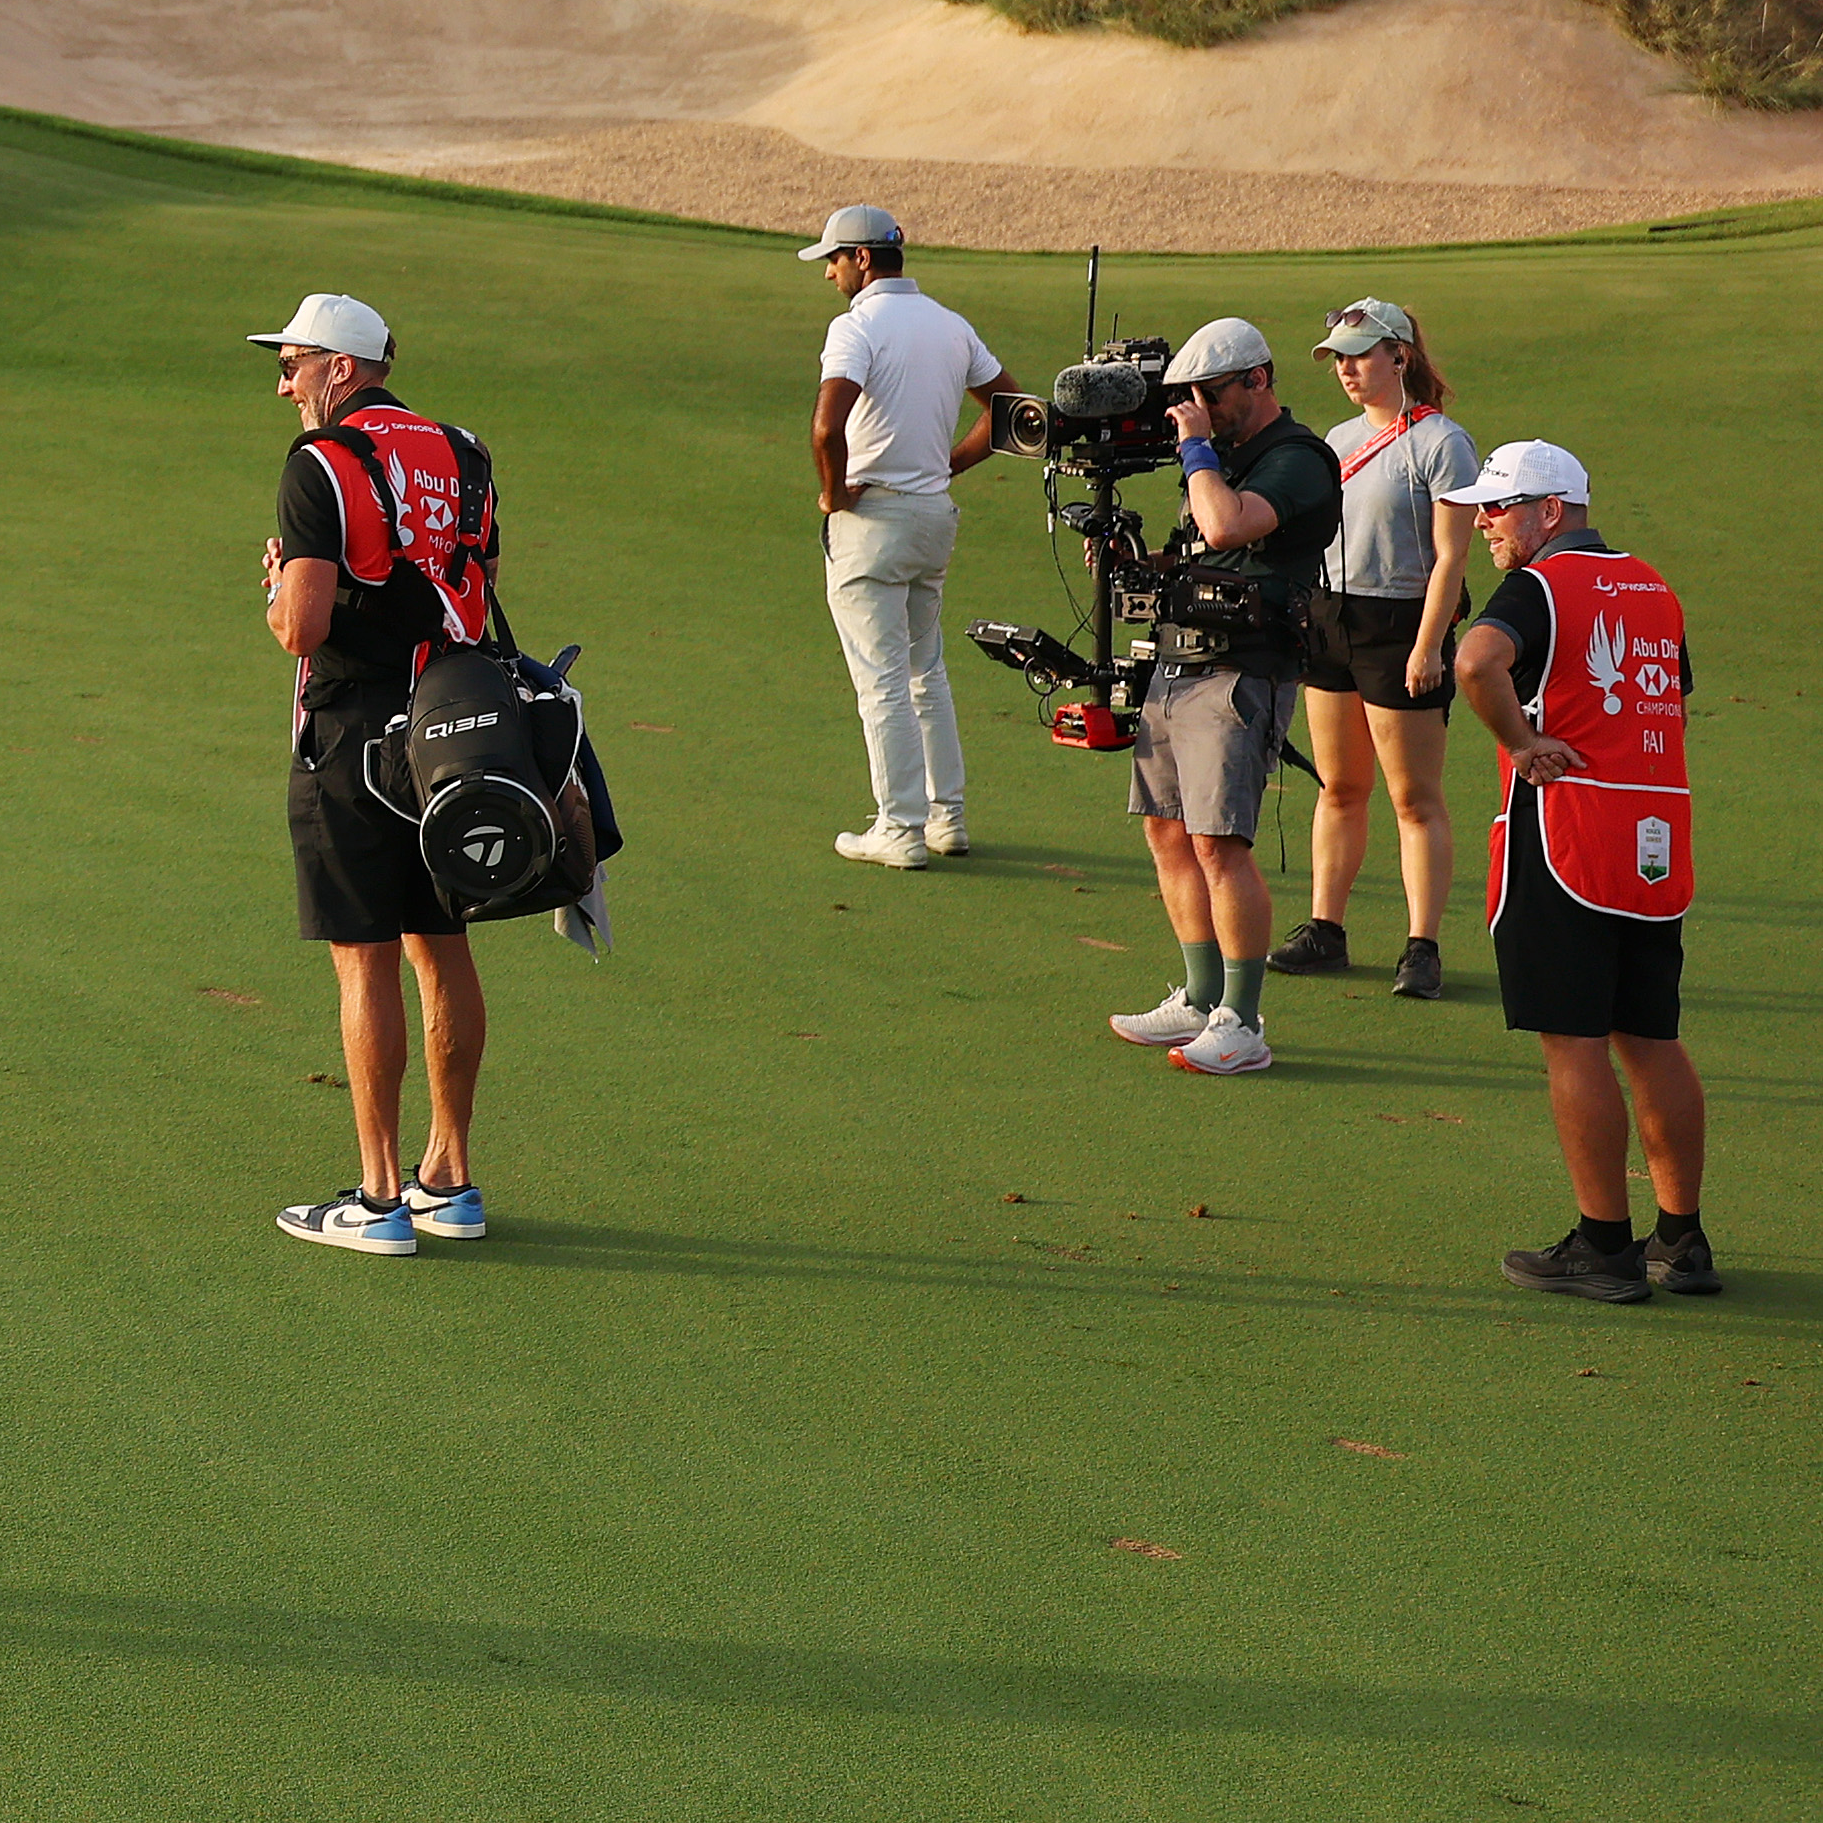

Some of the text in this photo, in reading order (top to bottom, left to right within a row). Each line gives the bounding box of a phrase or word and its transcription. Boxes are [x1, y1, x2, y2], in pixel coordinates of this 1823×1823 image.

[414, 468, 445, 493] Abu
[1633, 637, 1658, 657] Abu
[425, 711, 499, 740] Qi35
